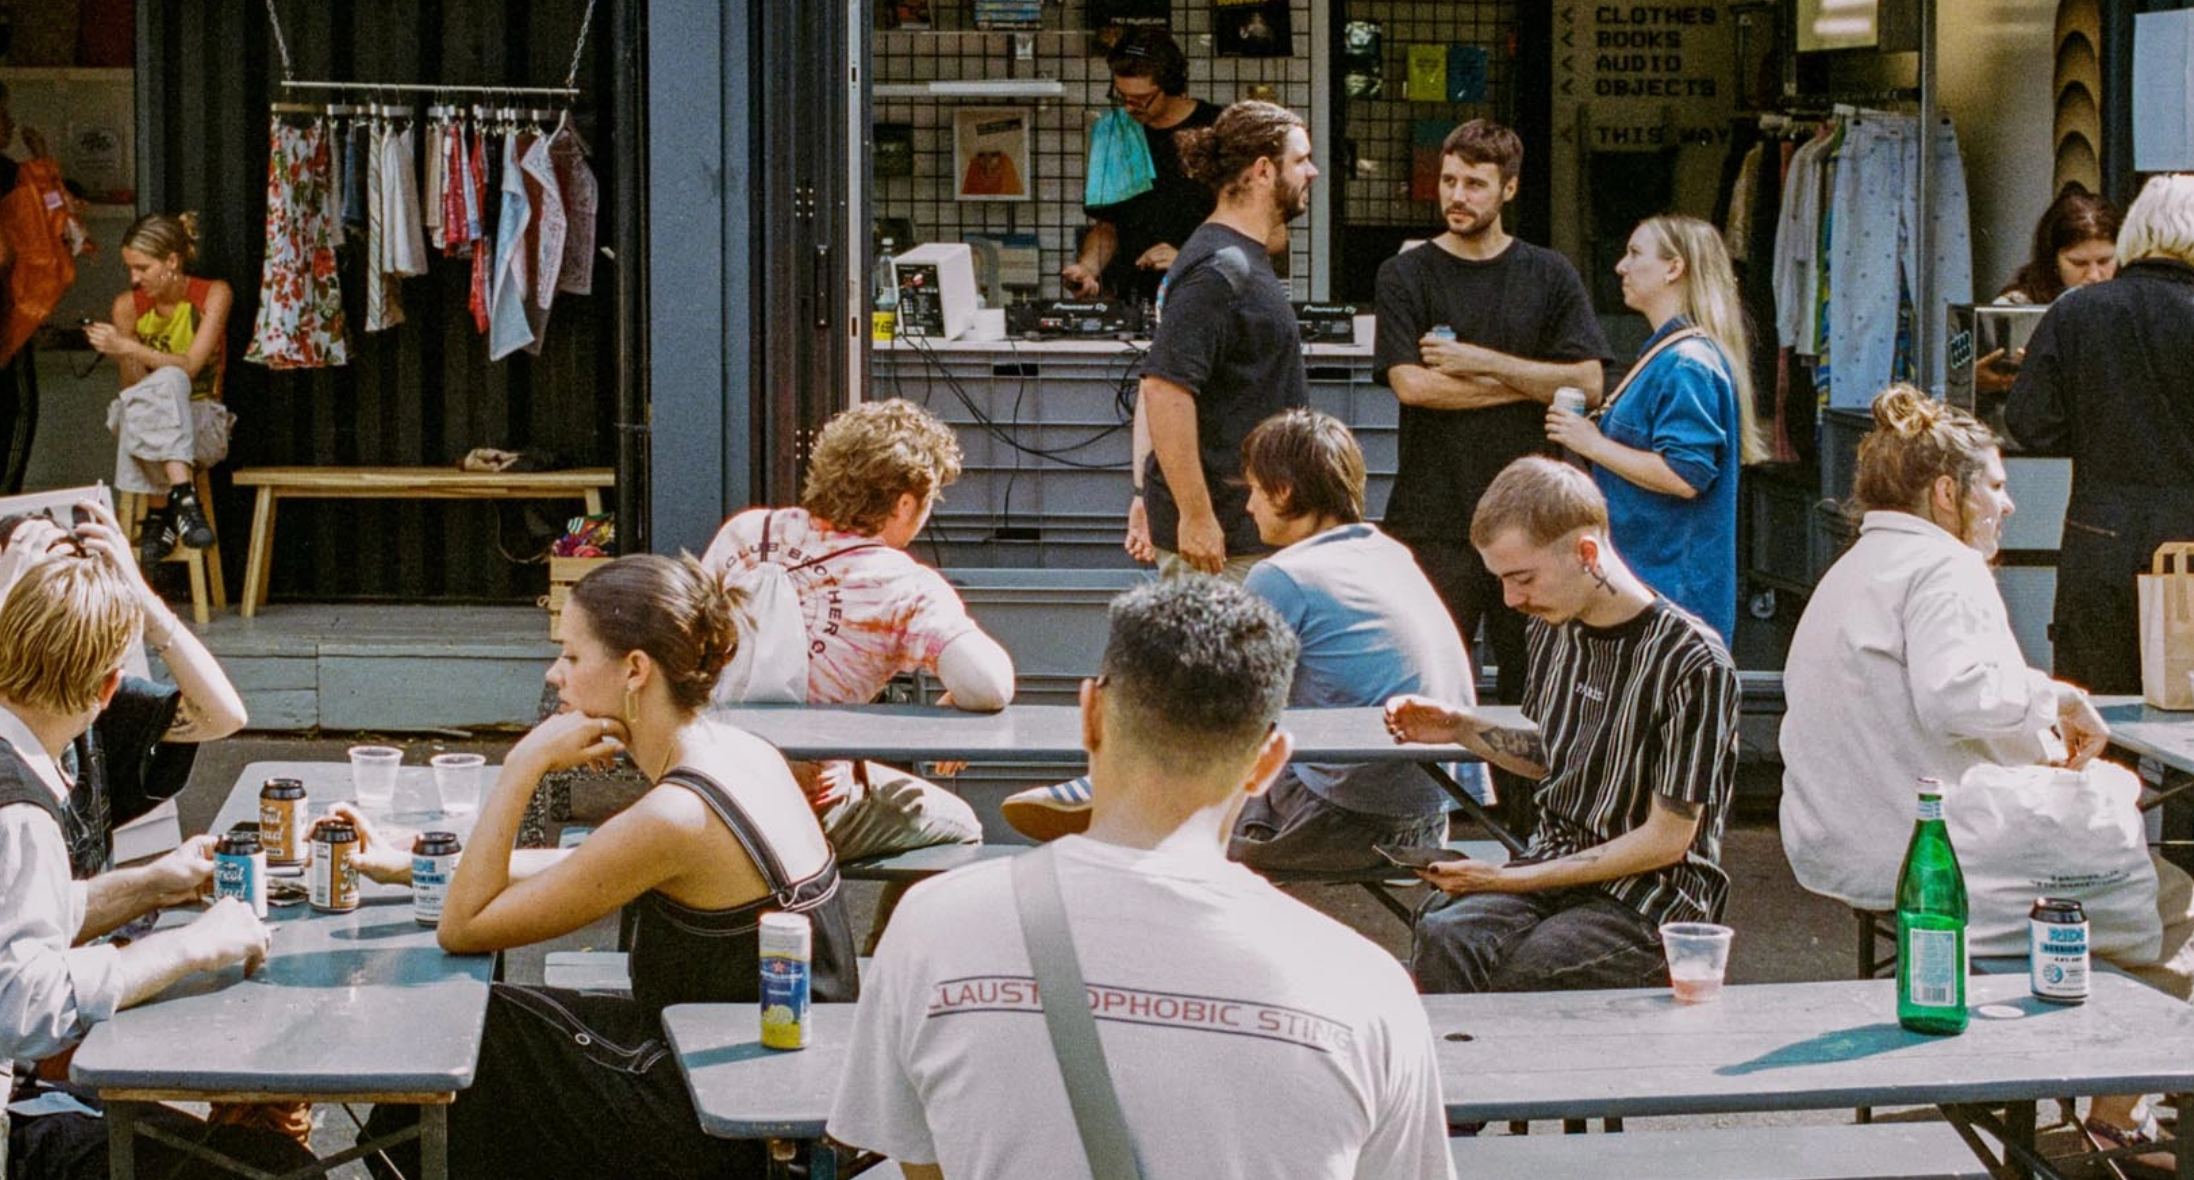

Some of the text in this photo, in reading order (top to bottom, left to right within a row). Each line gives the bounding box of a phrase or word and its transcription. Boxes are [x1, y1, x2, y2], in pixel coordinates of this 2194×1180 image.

[1596, 7, 1716, 24] CLOTHES
[1596, 31, 1681, 48] BOOKS
[1596, 55, 1681, 72] AUDIO
[1595, 79, 1716, 96] OBJECTS
[1596, 126, 1662, 144] THIS
[725, 542, 780, 569] CLUB
[929, 981, 1353, 1051] LAUSTPHOBIC STING
